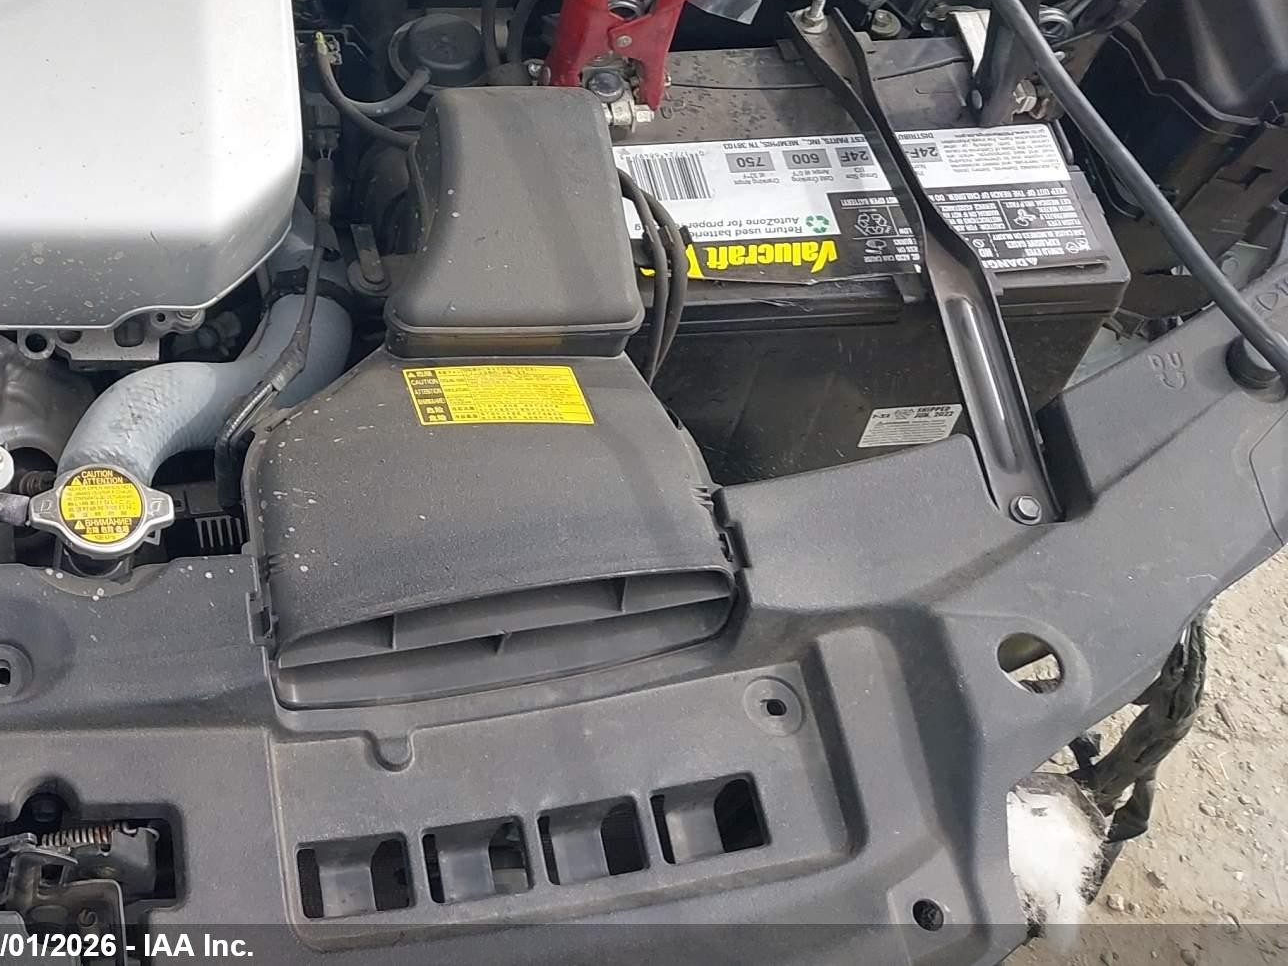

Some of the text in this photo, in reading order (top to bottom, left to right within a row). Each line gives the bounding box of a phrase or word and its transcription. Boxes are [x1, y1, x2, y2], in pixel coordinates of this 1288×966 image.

[905, 146, 938, 158] 24F-
[736, 150, 869, 167] 24F 600 750
[687, 218, 724, 230] proper
[727, 219, 743, 229] for
[745, 217, 799, 227] AutoZone
[734, 228, 762, 237] used
[764, 226, 803, 235] Return
[703, 240, 838, 274] Valucraft
[982, 258, 1029, 268] DANG
[81, 470, 113, 478] CAUTION
[82, 477, 123, 485] ATTENTION
